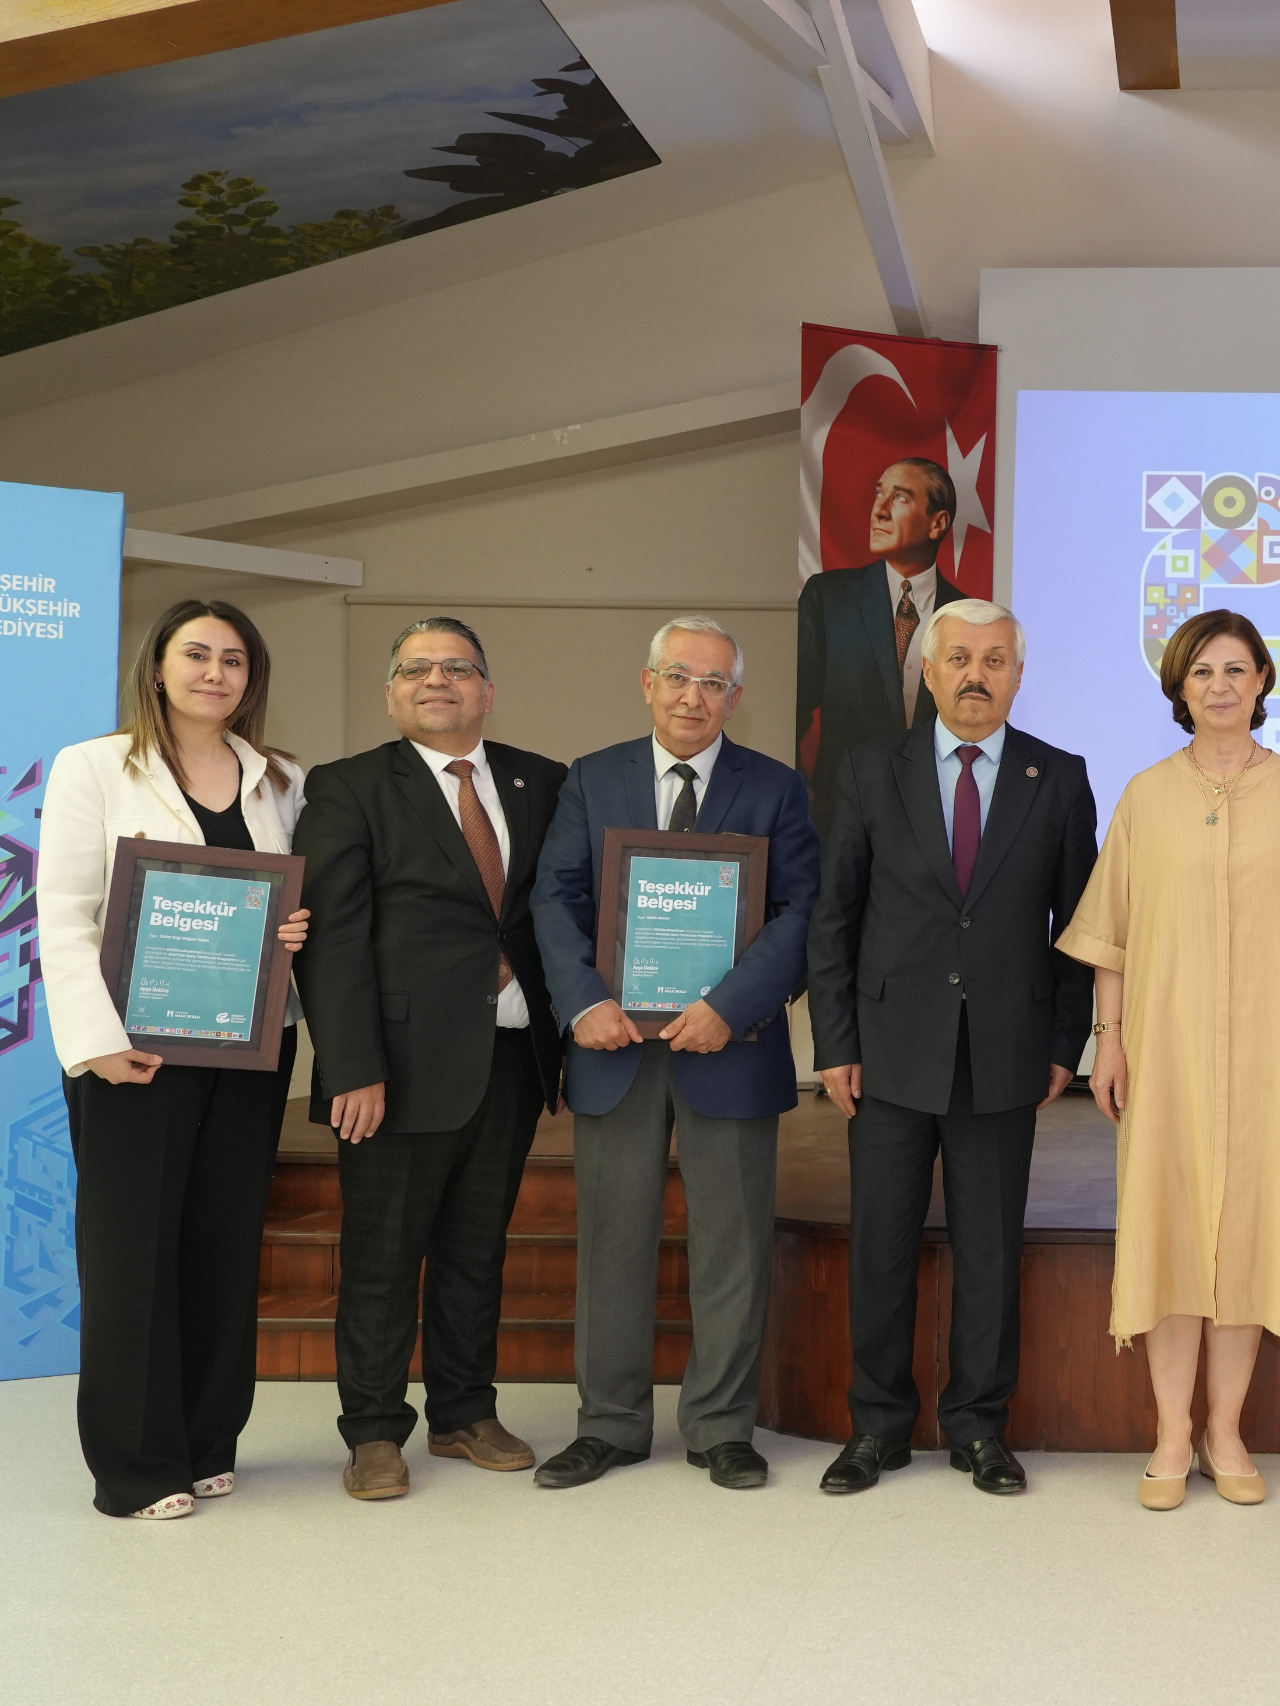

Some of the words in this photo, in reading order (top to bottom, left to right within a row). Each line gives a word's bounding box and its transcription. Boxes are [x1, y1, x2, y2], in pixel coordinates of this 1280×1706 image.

[0, 593, 81, 618] ÜKŞEHİR
[0, 617, 64, 639] DİYESİ
[638, 879, 712, 896] Teşekkür
[152, 896, 237, 917] Teşekkür
[637, 895, 697, 912] Belgesi
[149, 912, 219, 932] Belgesi
